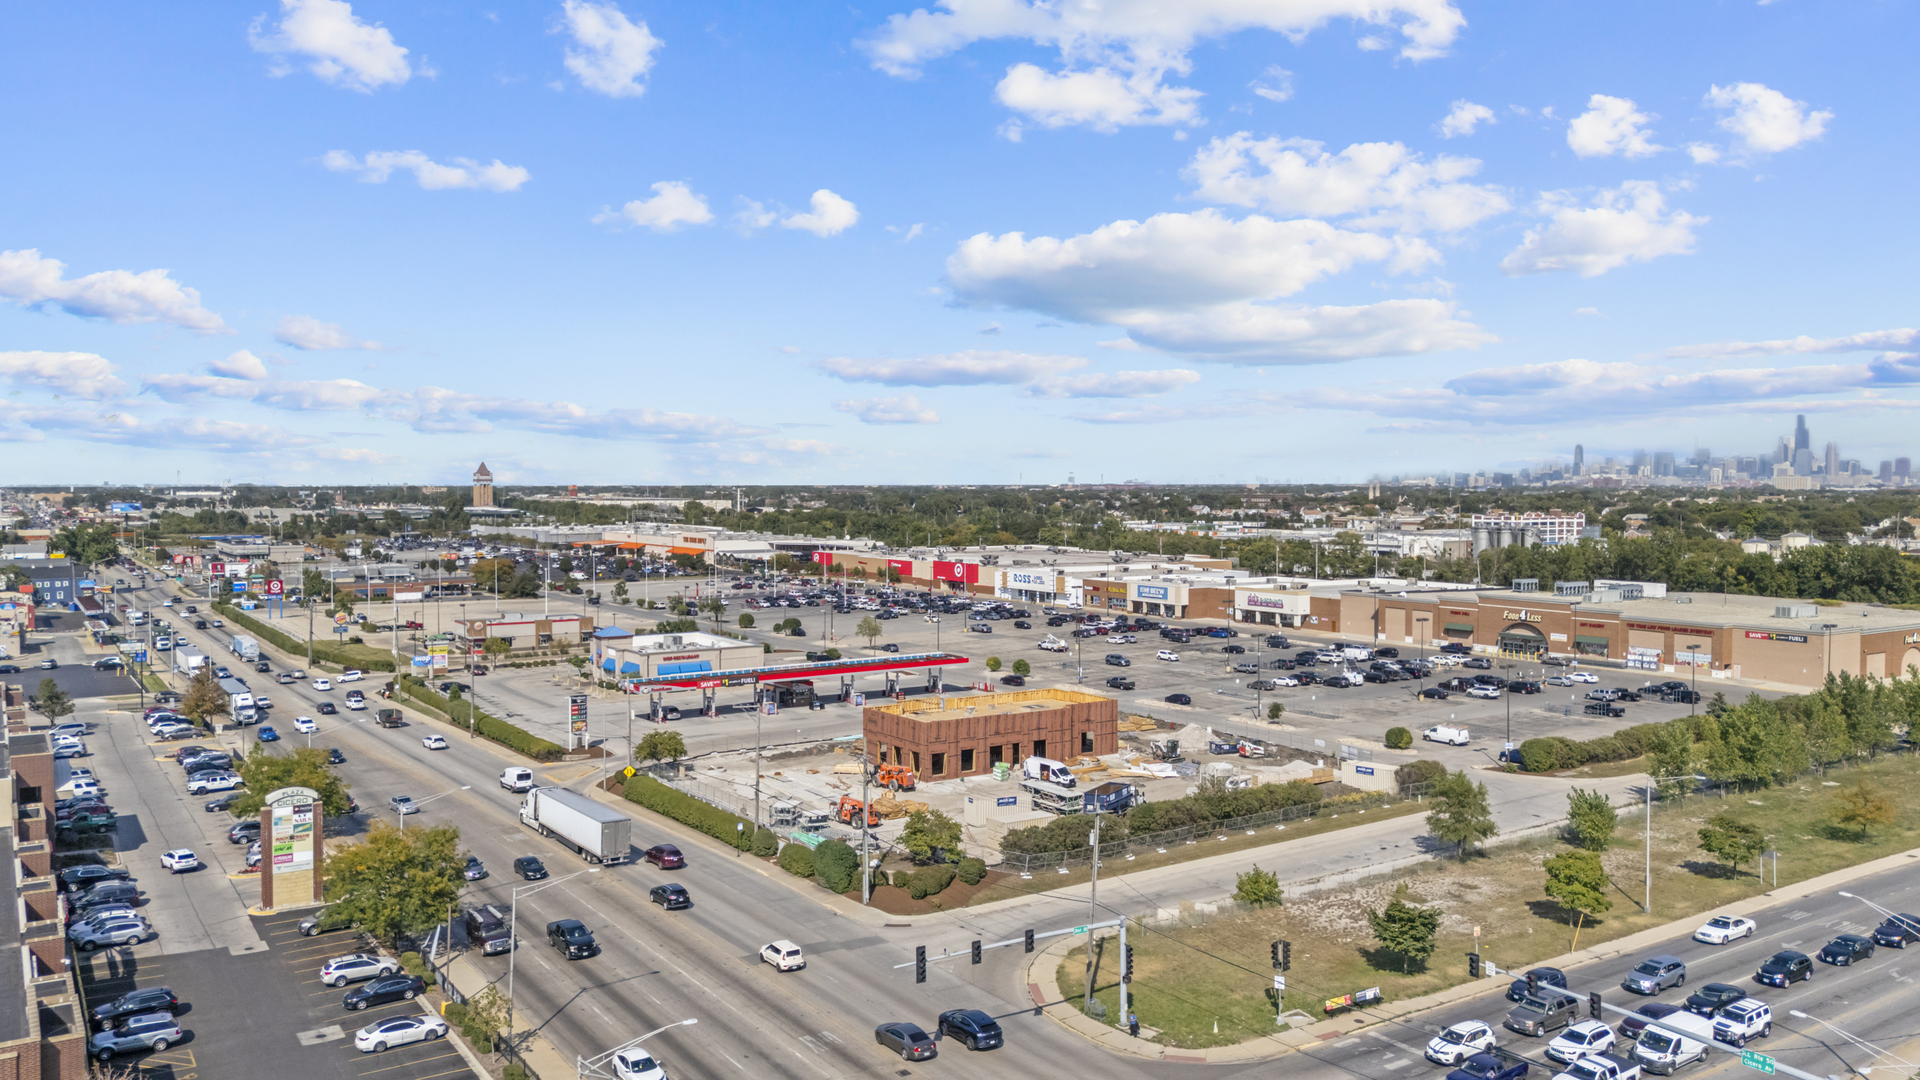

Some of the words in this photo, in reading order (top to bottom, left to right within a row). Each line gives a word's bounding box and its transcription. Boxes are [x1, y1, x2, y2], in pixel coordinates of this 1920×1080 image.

[1014, 574, 1031, 584] ROSS
[1520, 608, 1528, 621] 4
[277, 798, 308, 806] CICERO
[1744, 1058, 1762, 1068] Cicero
[1754, 1054, 1764, 1062] Rte
